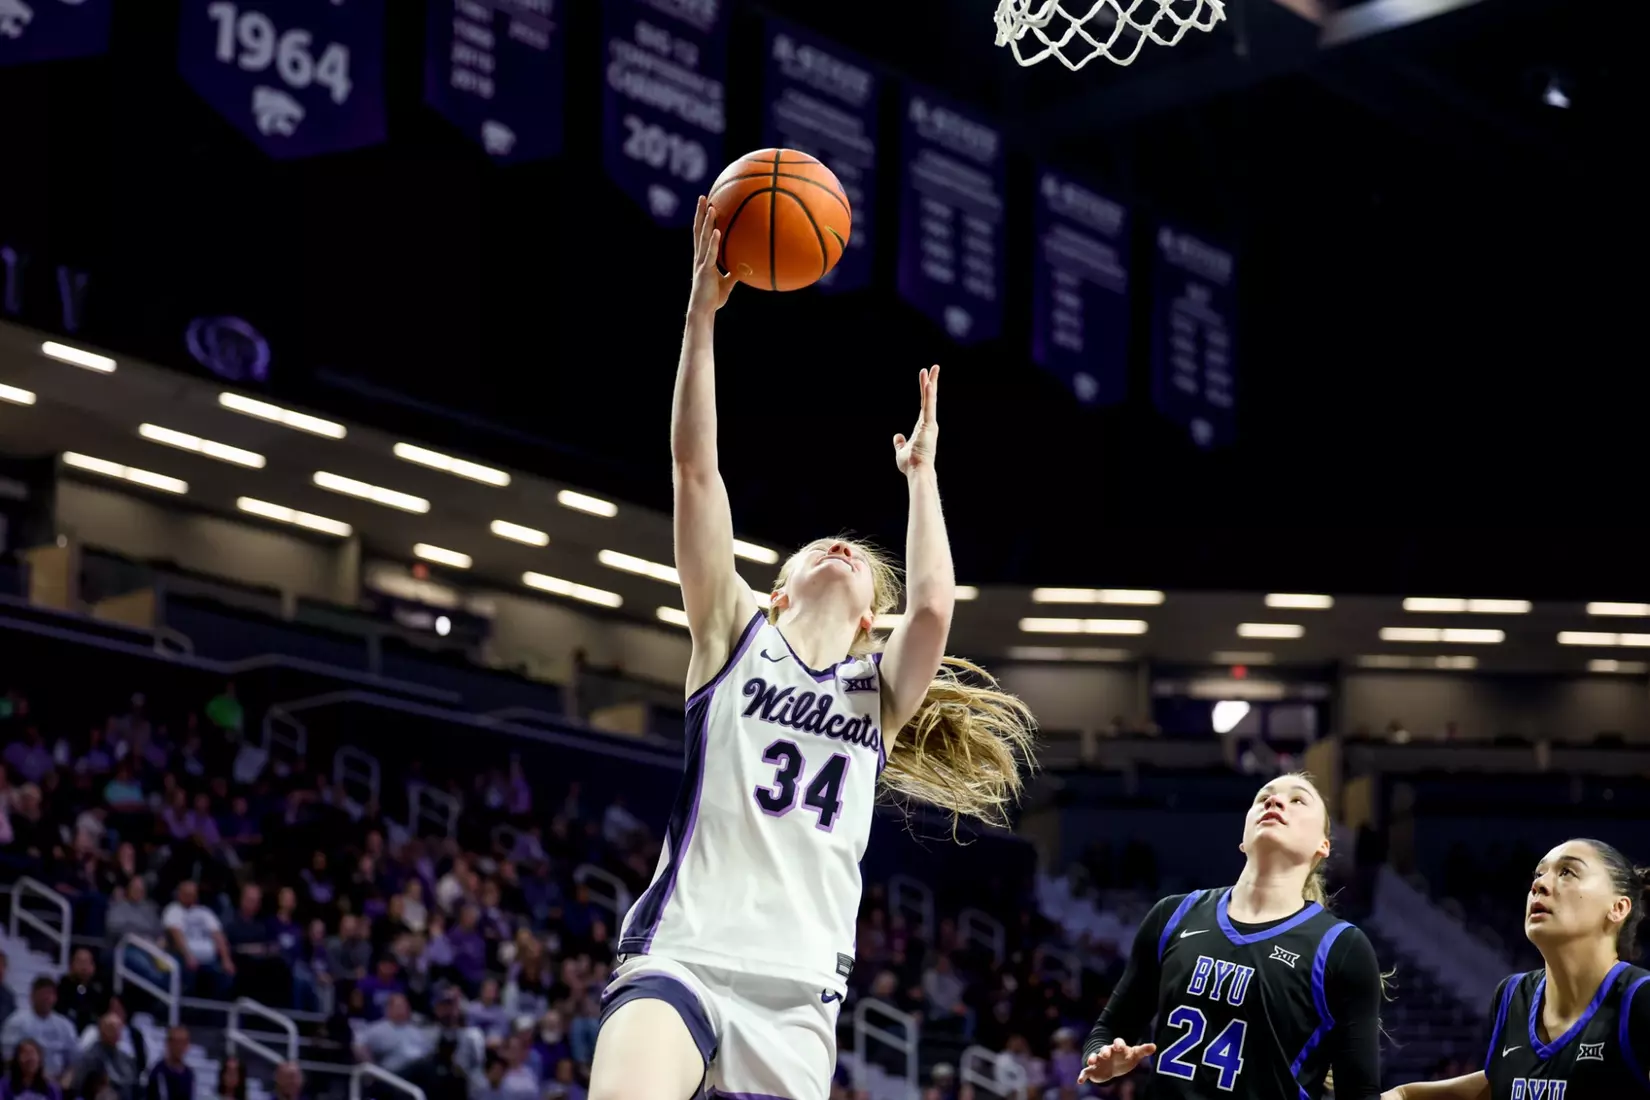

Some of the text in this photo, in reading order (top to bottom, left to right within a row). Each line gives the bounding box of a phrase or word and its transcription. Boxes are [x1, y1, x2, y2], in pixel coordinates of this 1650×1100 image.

[206, 1, 354, 106] 1964
[622, 113, 709, 183] 2019
[742, 677, 879, 752] Wildcats
[753, 738, 851, 834] 34
[1186, 955, 1255, 1007] BYU
[1156, 1004, 1248, 1092] 24
